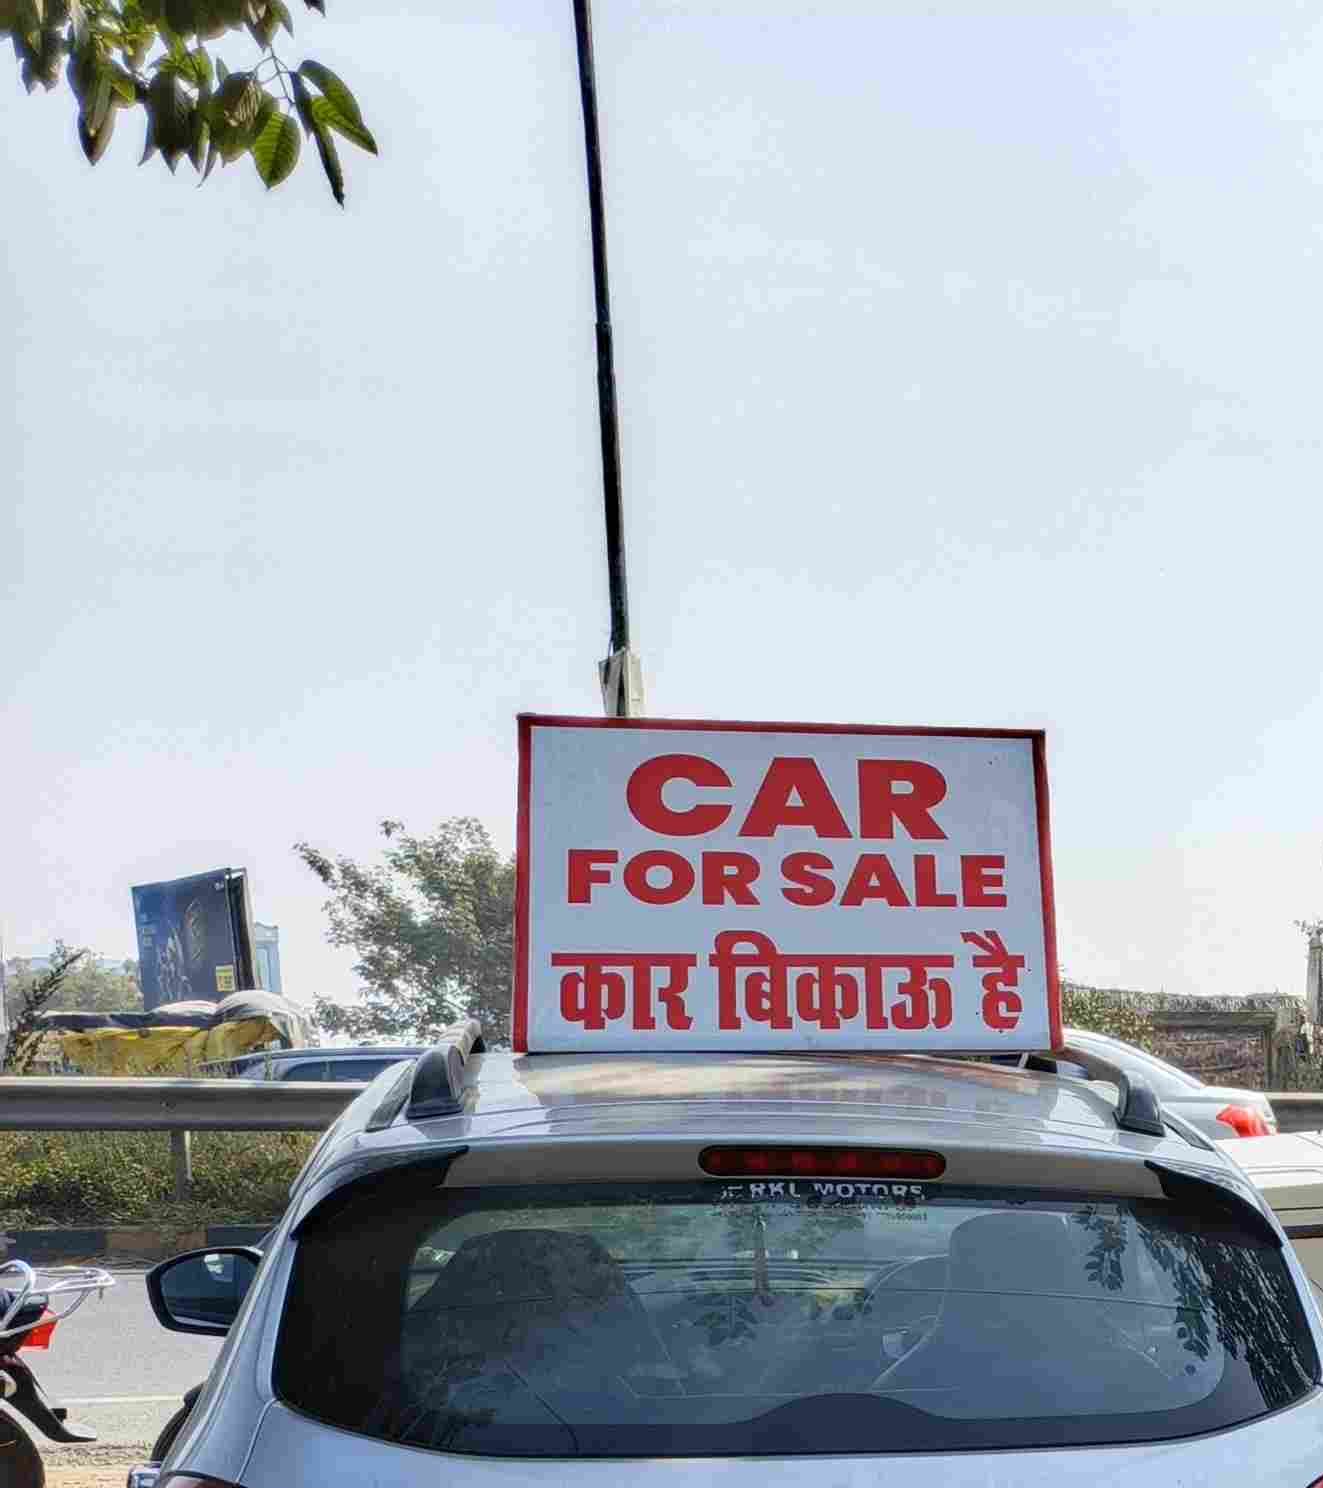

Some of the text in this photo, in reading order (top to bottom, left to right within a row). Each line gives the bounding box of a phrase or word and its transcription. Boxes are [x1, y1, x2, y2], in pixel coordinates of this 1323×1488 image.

[626, 753, 949, 840] CAR
[567, 849, 1008, 908] FOR SALE
[551, 929, 1025, 1031] कार बिकाऊ है
